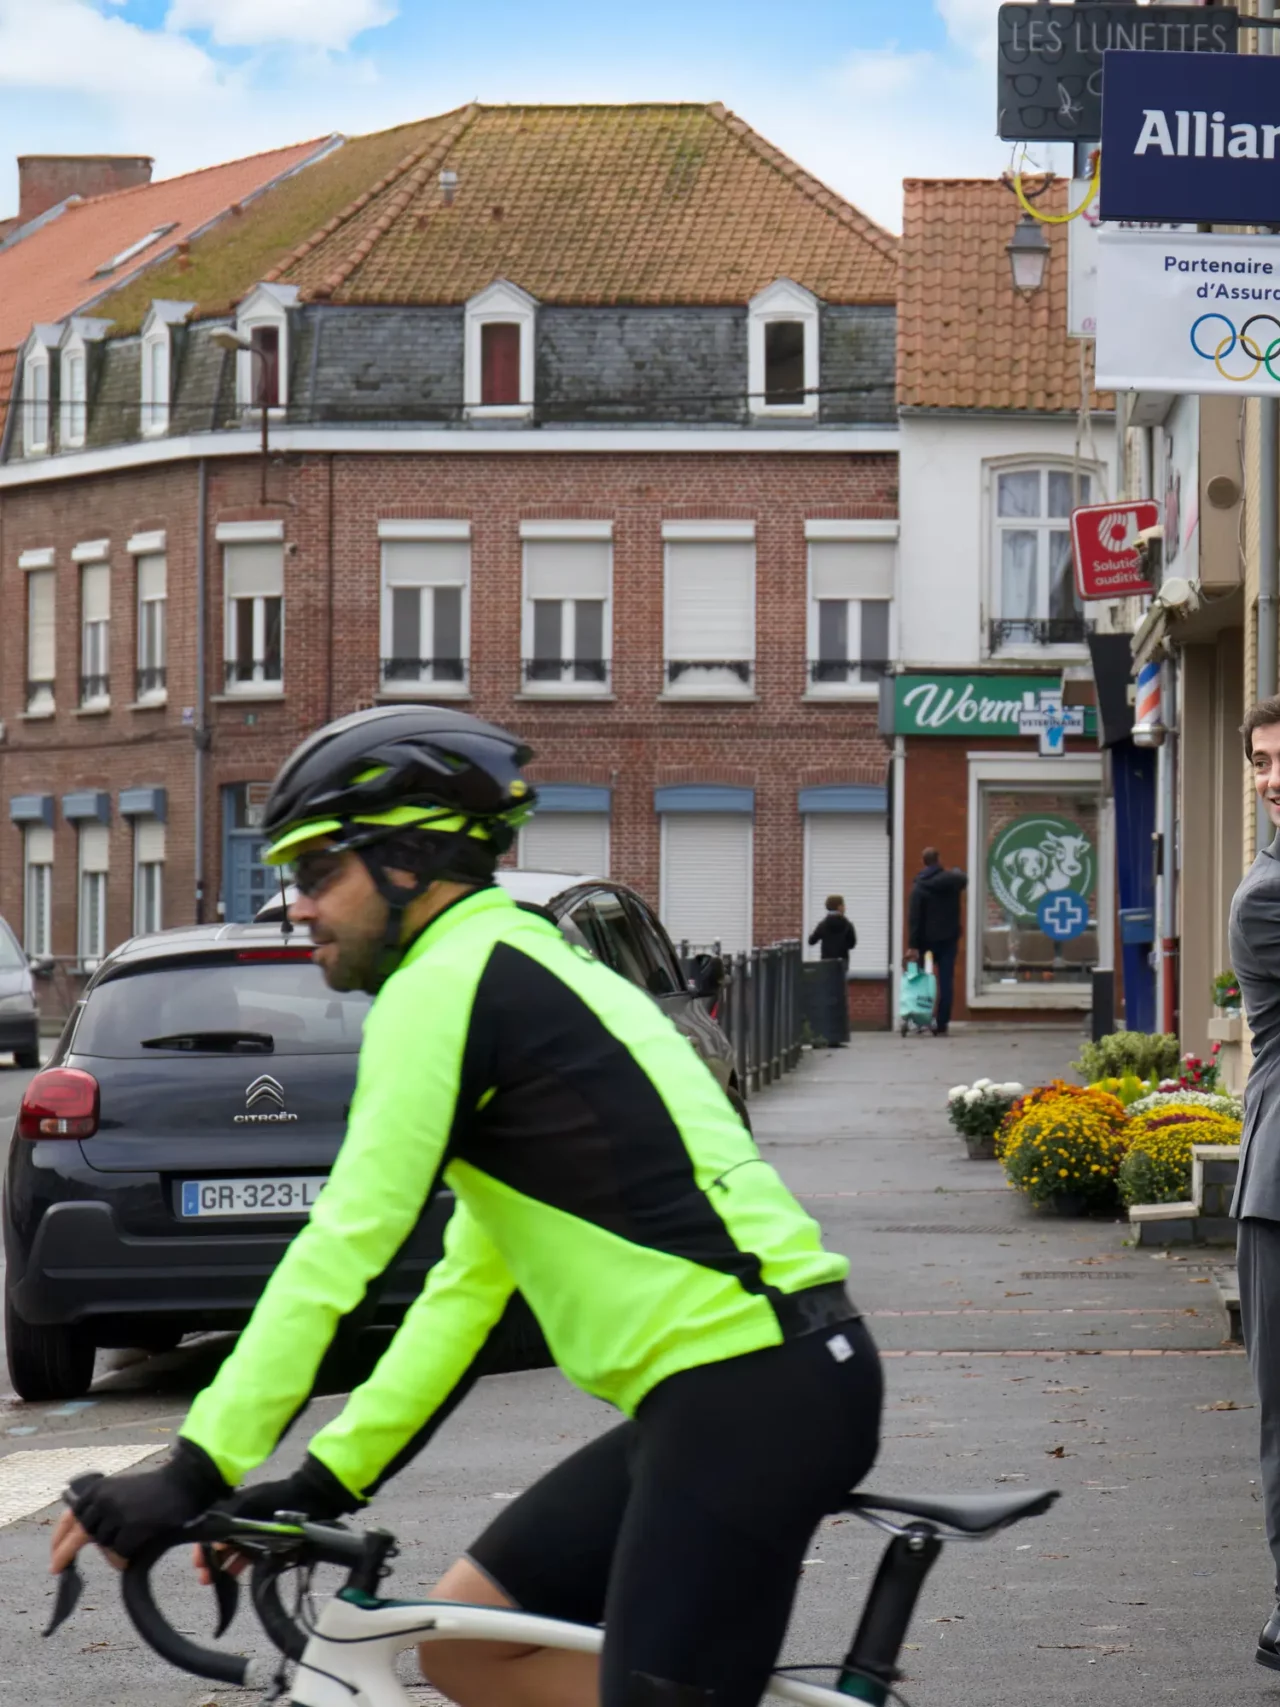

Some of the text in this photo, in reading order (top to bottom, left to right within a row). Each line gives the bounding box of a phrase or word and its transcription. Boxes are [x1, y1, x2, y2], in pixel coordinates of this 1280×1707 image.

[1012, 20, 1227, 53] LES LUNETTES
[1164, 255, 1273, 275] Partenaire
[201, 1183, 327, 1210] GR-323-L
